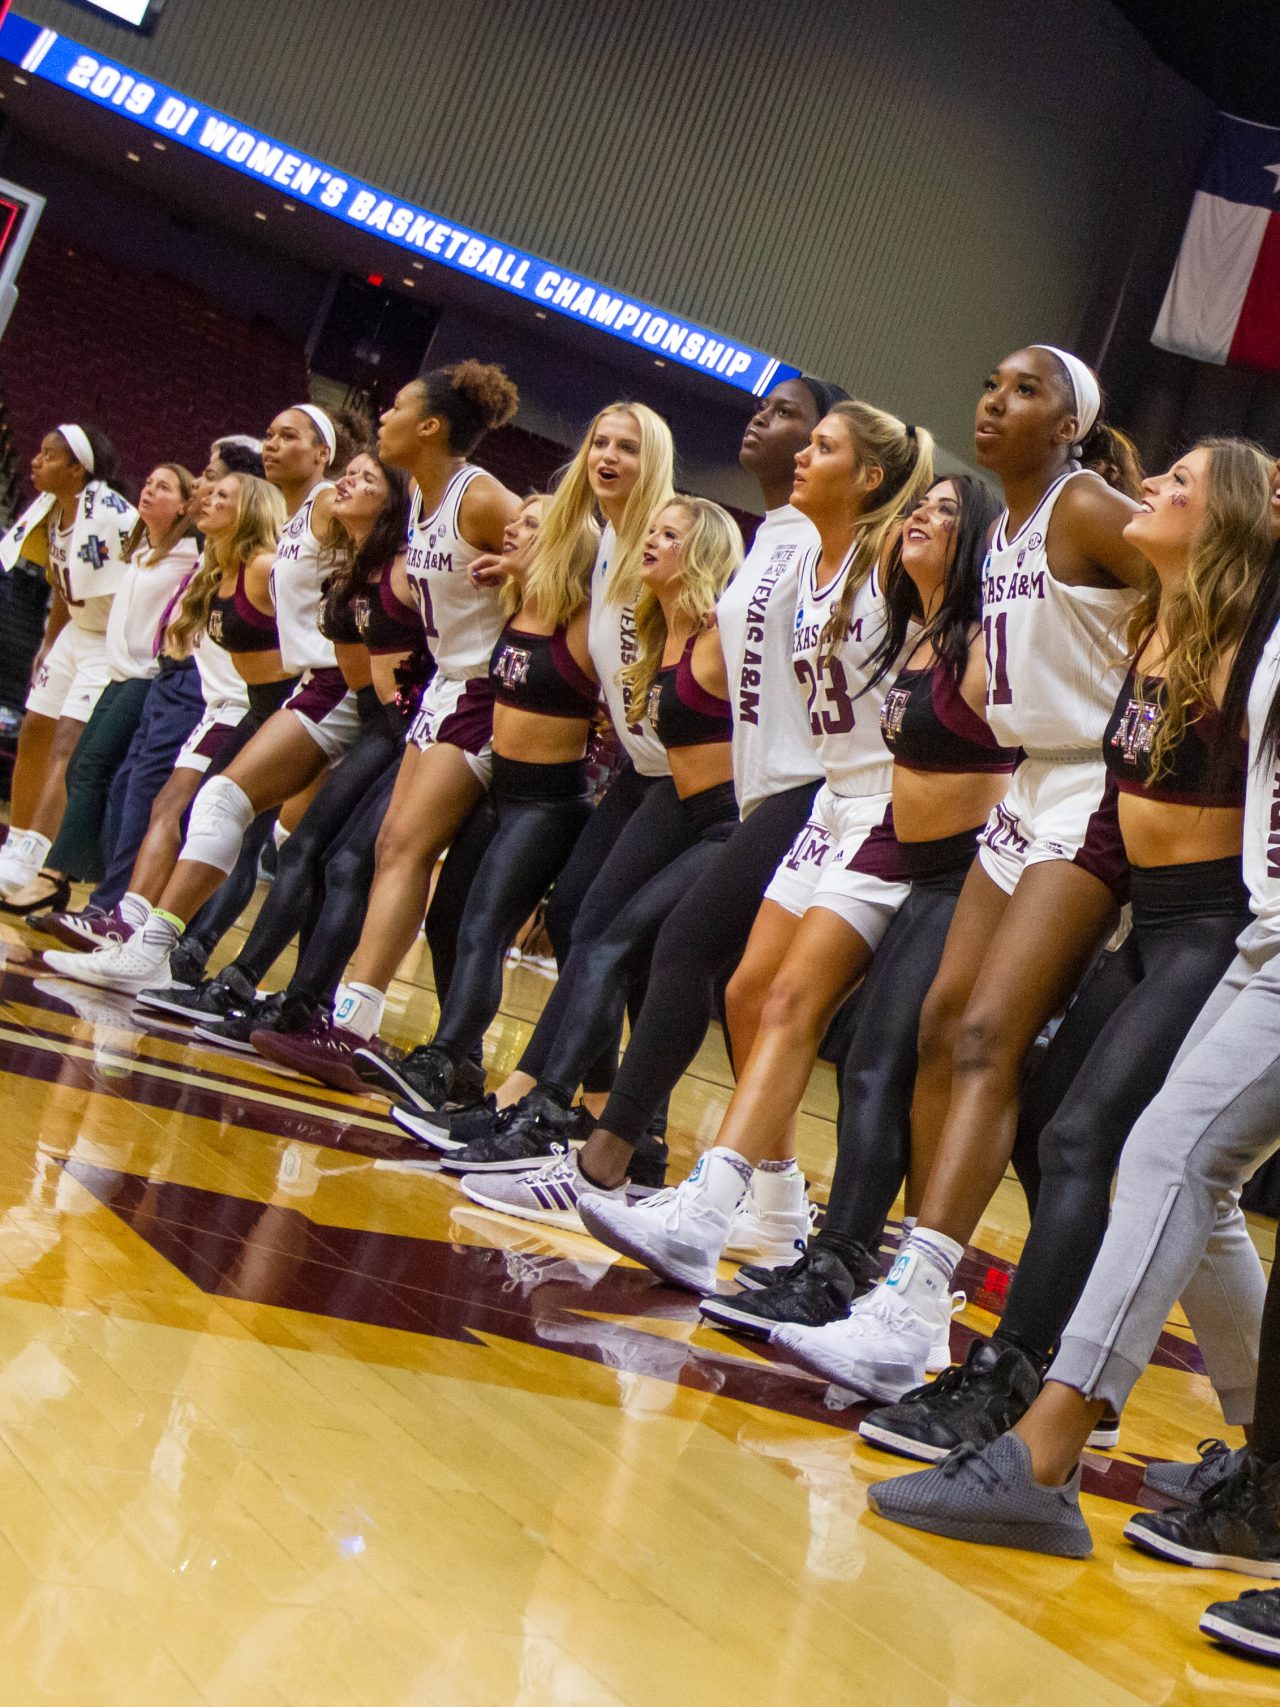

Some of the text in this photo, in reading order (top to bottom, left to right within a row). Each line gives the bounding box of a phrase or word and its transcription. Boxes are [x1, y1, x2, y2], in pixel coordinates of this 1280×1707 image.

[67, 55, 752, 378] 2019 DI WOMEN'S BASKETBALL CHAMPIONSHIP
[423, 551, 454, 573] A&M
[1007, 571, 1046, 600] A&M
[739, 577, 779, 727] TEXAS A&M
[793, 624, 820, 653] EXAS
[984, 612, 1013, 706] 11
[794, 655, 856, 736] 23
